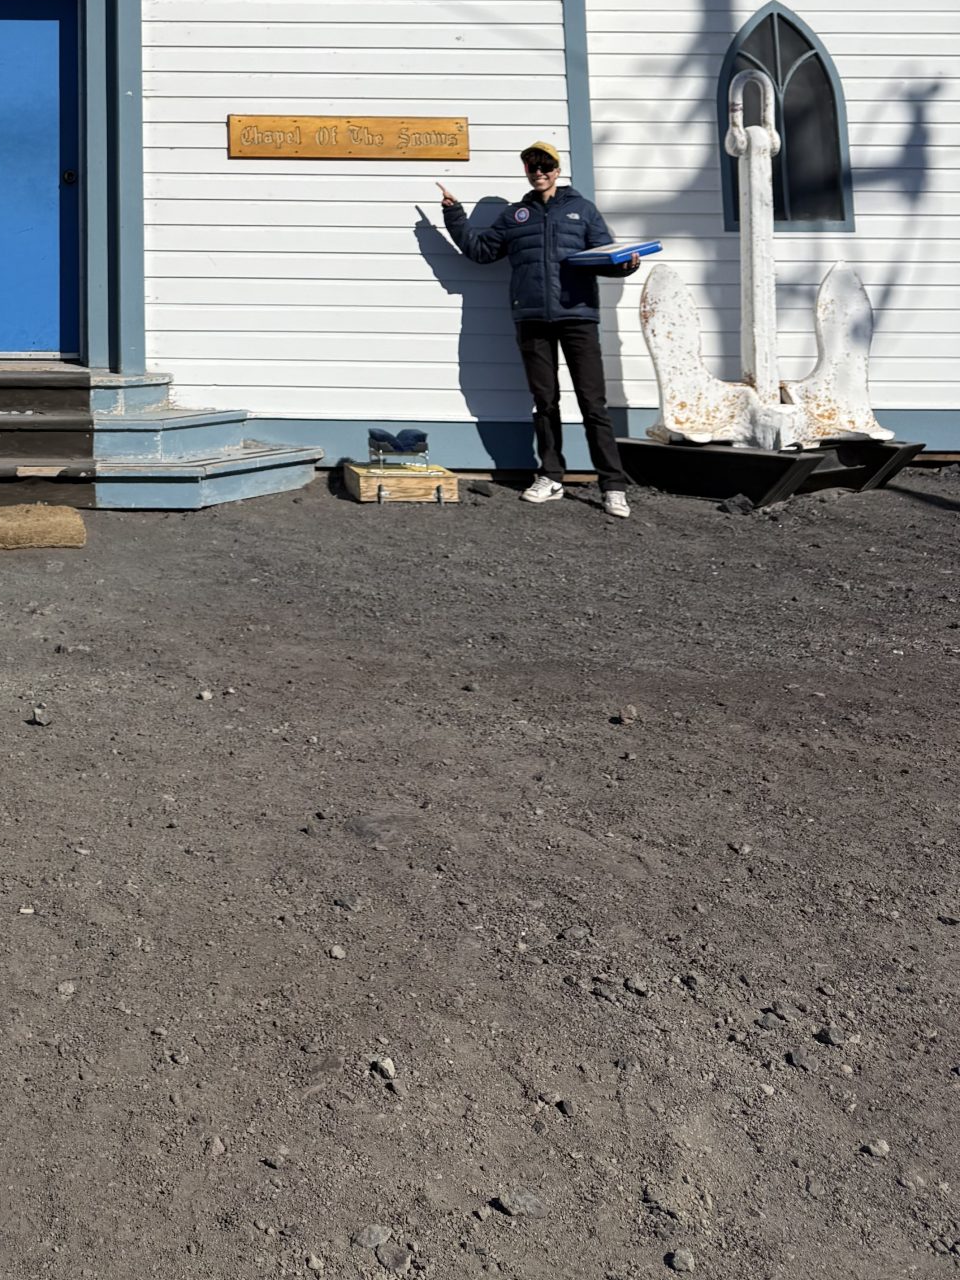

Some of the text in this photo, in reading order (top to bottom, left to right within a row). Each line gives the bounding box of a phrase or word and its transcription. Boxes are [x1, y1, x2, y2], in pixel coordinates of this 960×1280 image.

[240, 124, 459, 149] Chapel Of The Snows
